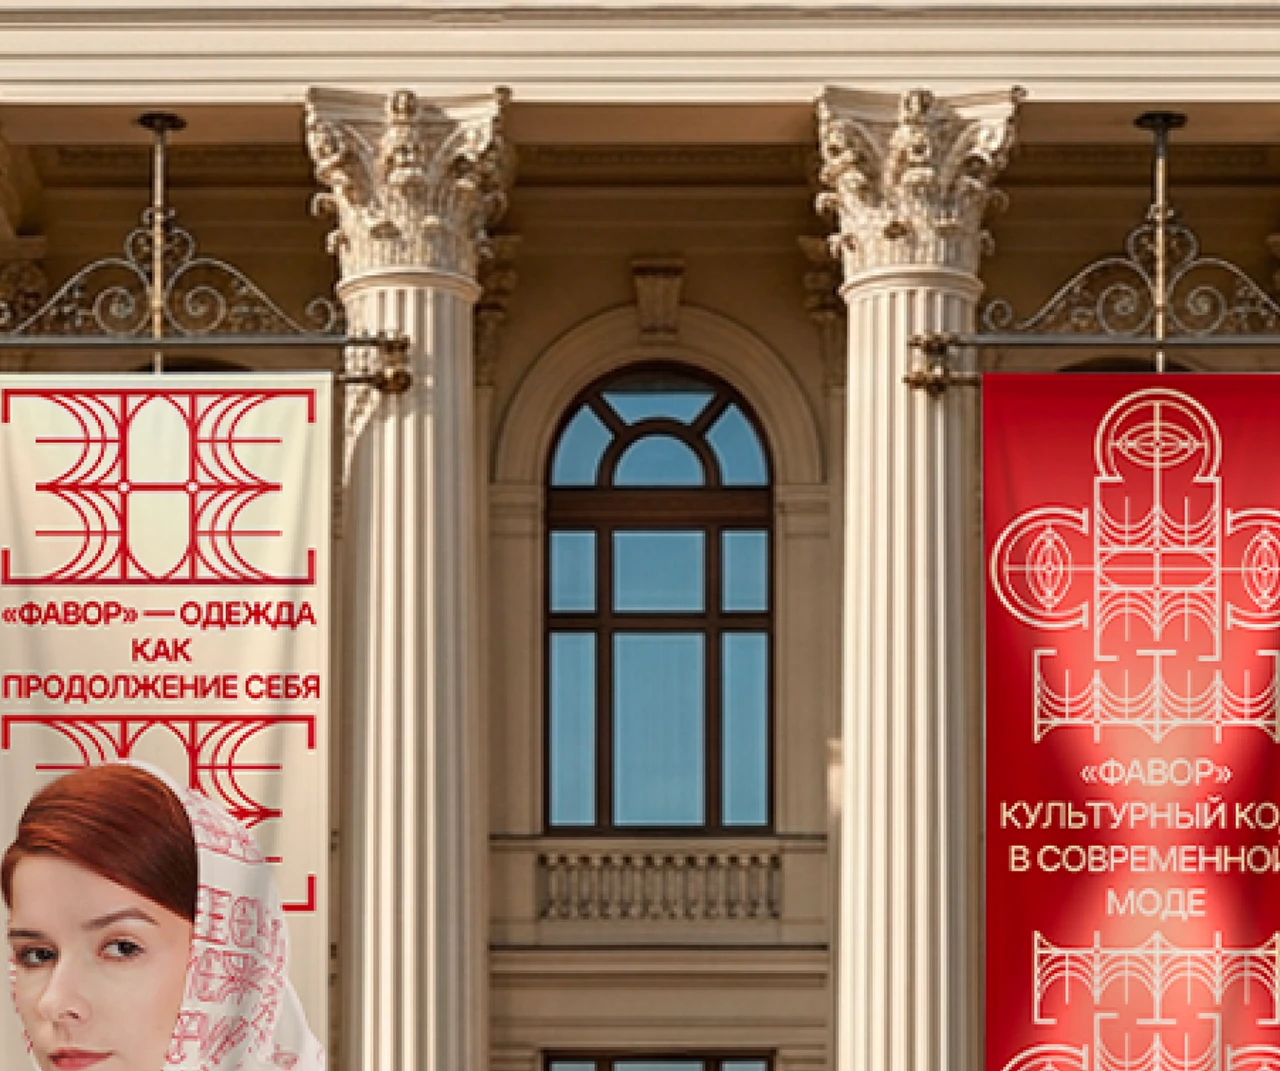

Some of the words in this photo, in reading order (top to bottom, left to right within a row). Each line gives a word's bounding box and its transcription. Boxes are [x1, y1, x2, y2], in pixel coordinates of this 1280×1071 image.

[2, 601, 138, 626] «ФАВОР»
[180, 601, 316, 630] ОДЕЖДА
[131, 638, 192, 662] КАК
[2, 674, 238, 704] ПРОДОЛЖЕНИЕ
[244, 674, 321, 699] СЕБЯ
[1080, 758, 1233, 786] «ФАВОР»
[1000, 794, 1227, 829] КУЛЬТУРНЫЙ
[1010, 845, 1030, 872] В
[1106, 888, 1207, 921] МОДЕ
